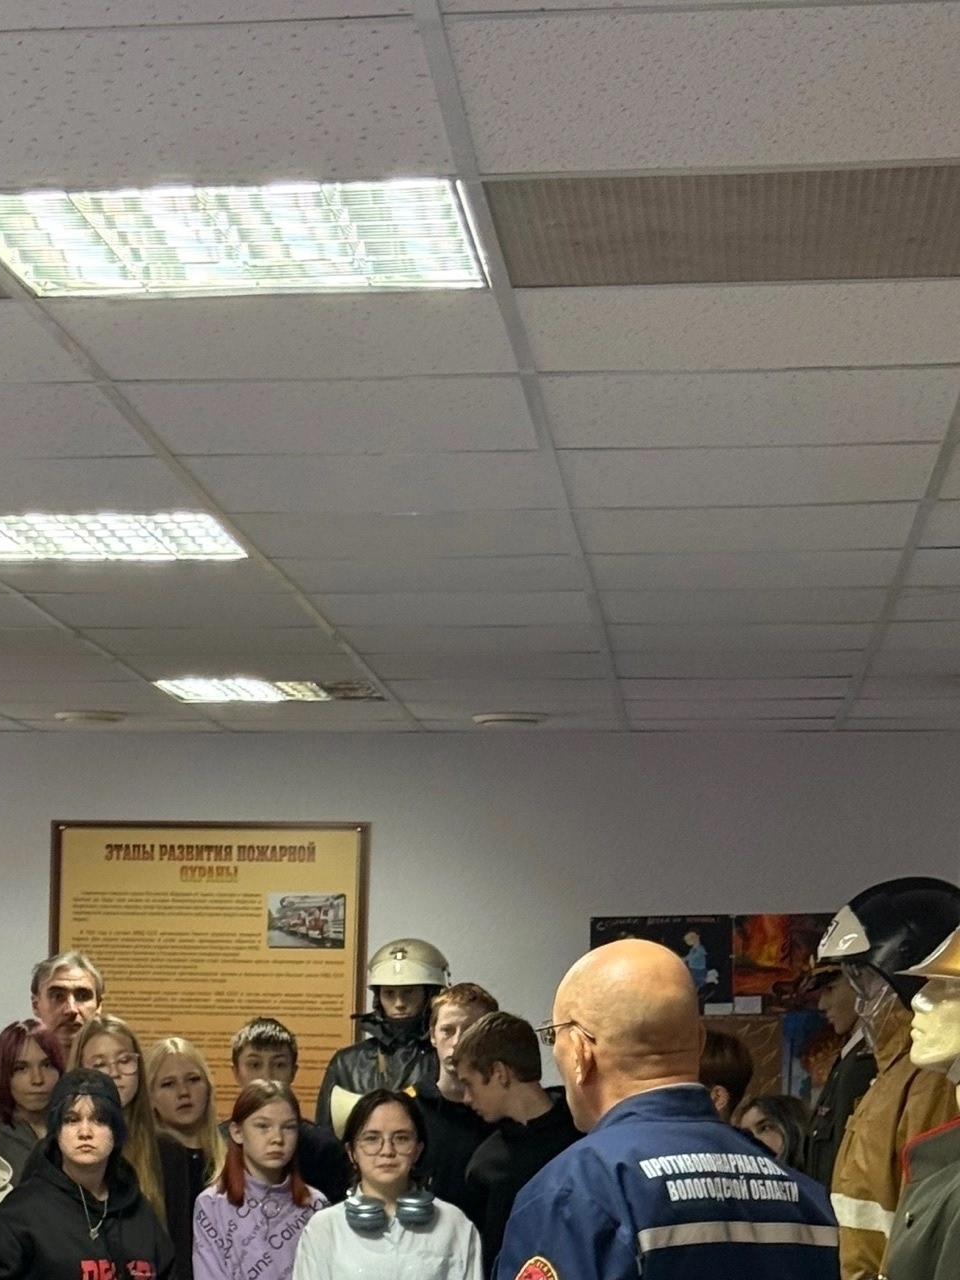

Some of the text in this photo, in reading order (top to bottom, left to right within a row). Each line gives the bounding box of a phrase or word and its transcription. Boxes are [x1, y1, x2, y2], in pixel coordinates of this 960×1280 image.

[104, 842, 316, 863] ЭТАПЫ РАЗВИТИЯ ПОЖАРНОЙ
[179, 865, 239, 883] ОХРАНЫ
[666, 1175, 799, 1203] ВОЛОГОДСКОЙ ОБЛАСТИ
